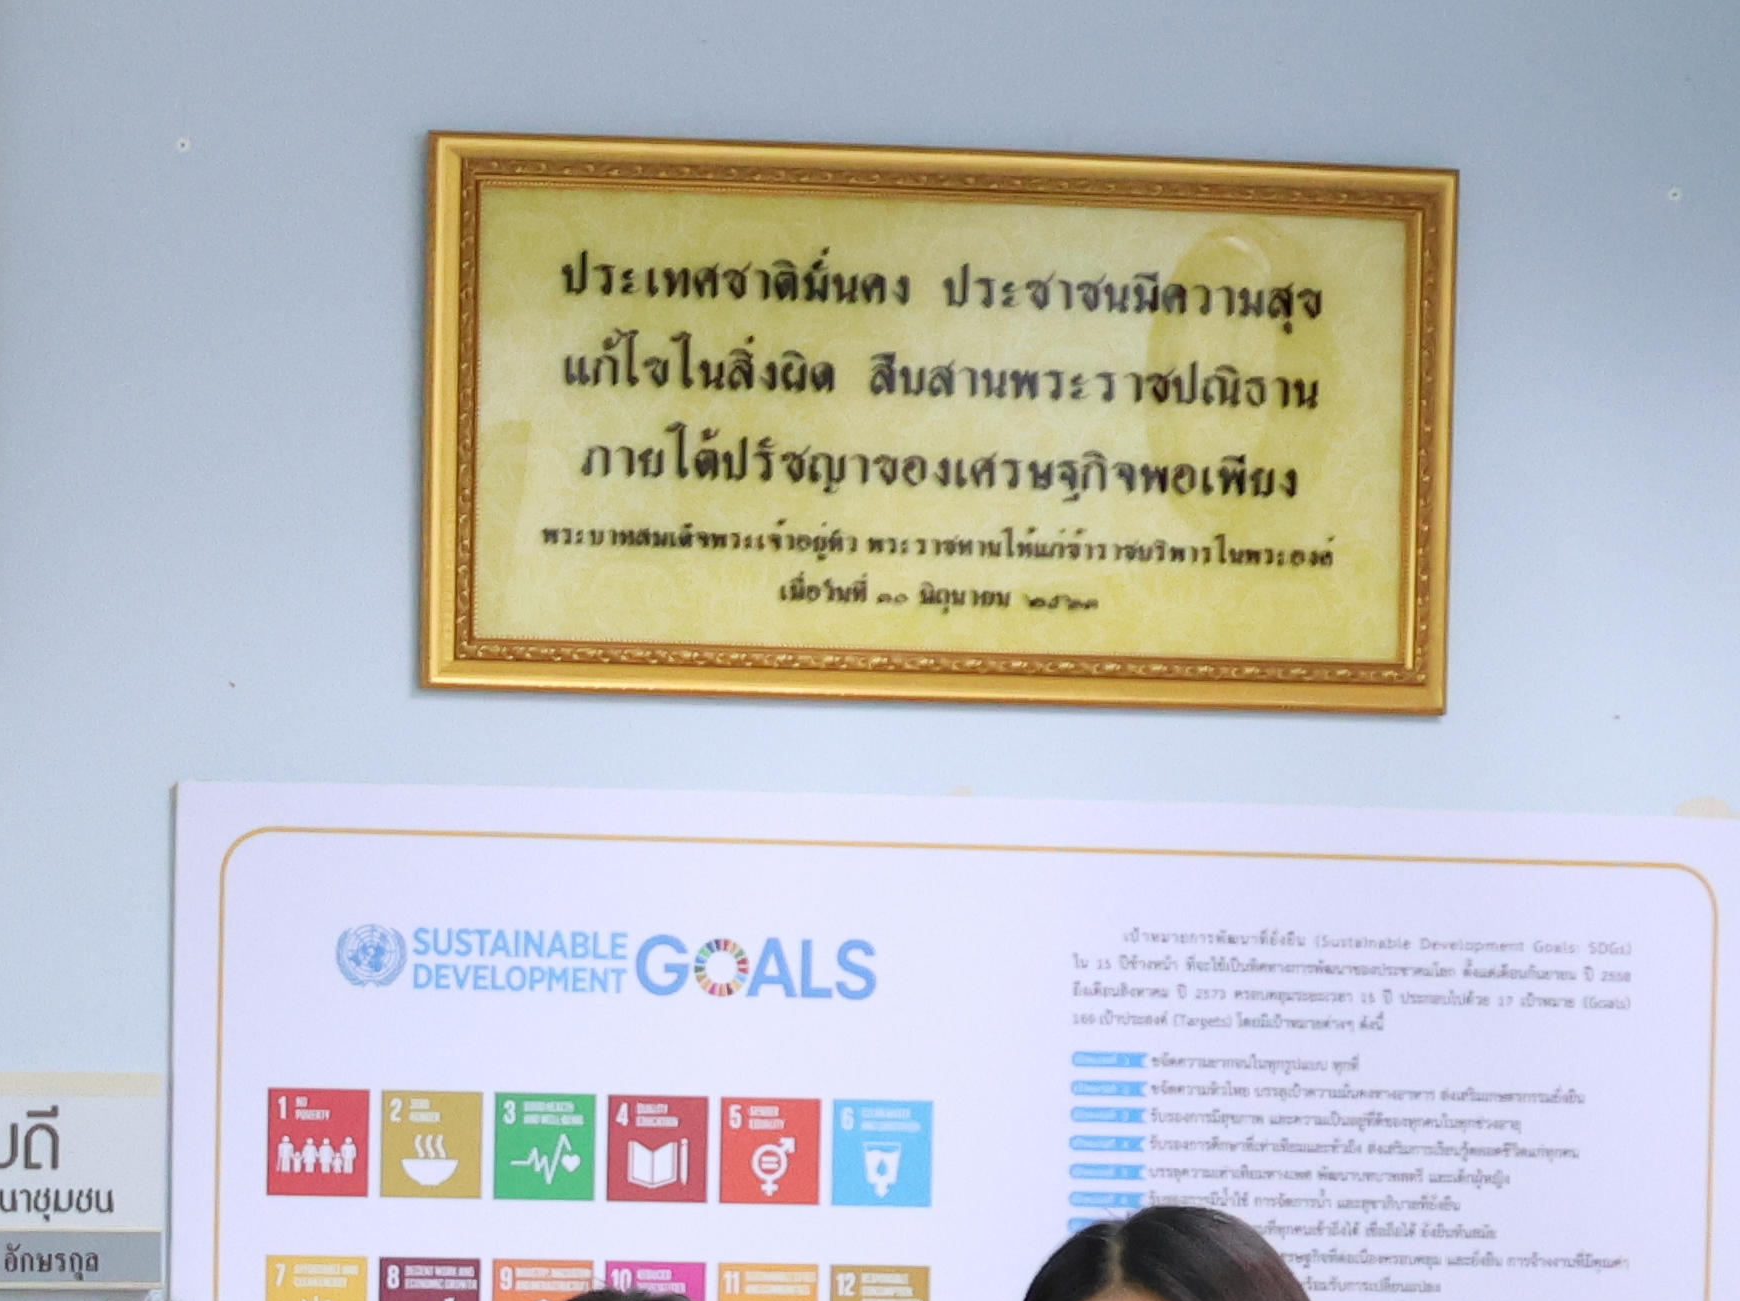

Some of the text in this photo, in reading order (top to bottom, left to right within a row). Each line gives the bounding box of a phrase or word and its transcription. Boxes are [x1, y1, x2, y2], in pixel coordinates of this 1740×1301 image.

[561, 247, 1323, 334] ประเทศชาติมั่นคง ประชาชนมีความสุข
[563, 328, 1319, 409] แก้ไขในสิ่งผิด สืบสานพระราชปณิธาน
[581, 421, 1298, 502] ภายใต้ปรัชญาของเศรษฐกิจพอเพียง
[542, 519, 858, 561] พระบาทสมเด็จพระเจ้าอยู่หัว
[779, 572, 868, 604] เมื่อวันที่
[412, 927, 628, 961] SUSTAINABLE
[1420, 937, 1524, 953] Development
[412, 964, 626, 995] DEVELOPMENT
[635, 933, 876, 1001] GOALS
[278, 1095, 287, 1120] 1
[389, 1098, 402, 1122] 2
[502, 1100, 516, 1124] 3
[615, 1102, 629, 1126] 4
[729, 1104, 742, 1129] 5
[841, 1107, 854, 1130] 6
[4, 1243, 99, 1280] อักษรกุล
[387, 1265, 400, 1289] 8
[499, 1266, 513, 1290] 9
[611, 1269, 633, 1293] 10
[724, 1271, 741, 1294] 11
[836, 1272, 855, 1297] 12
